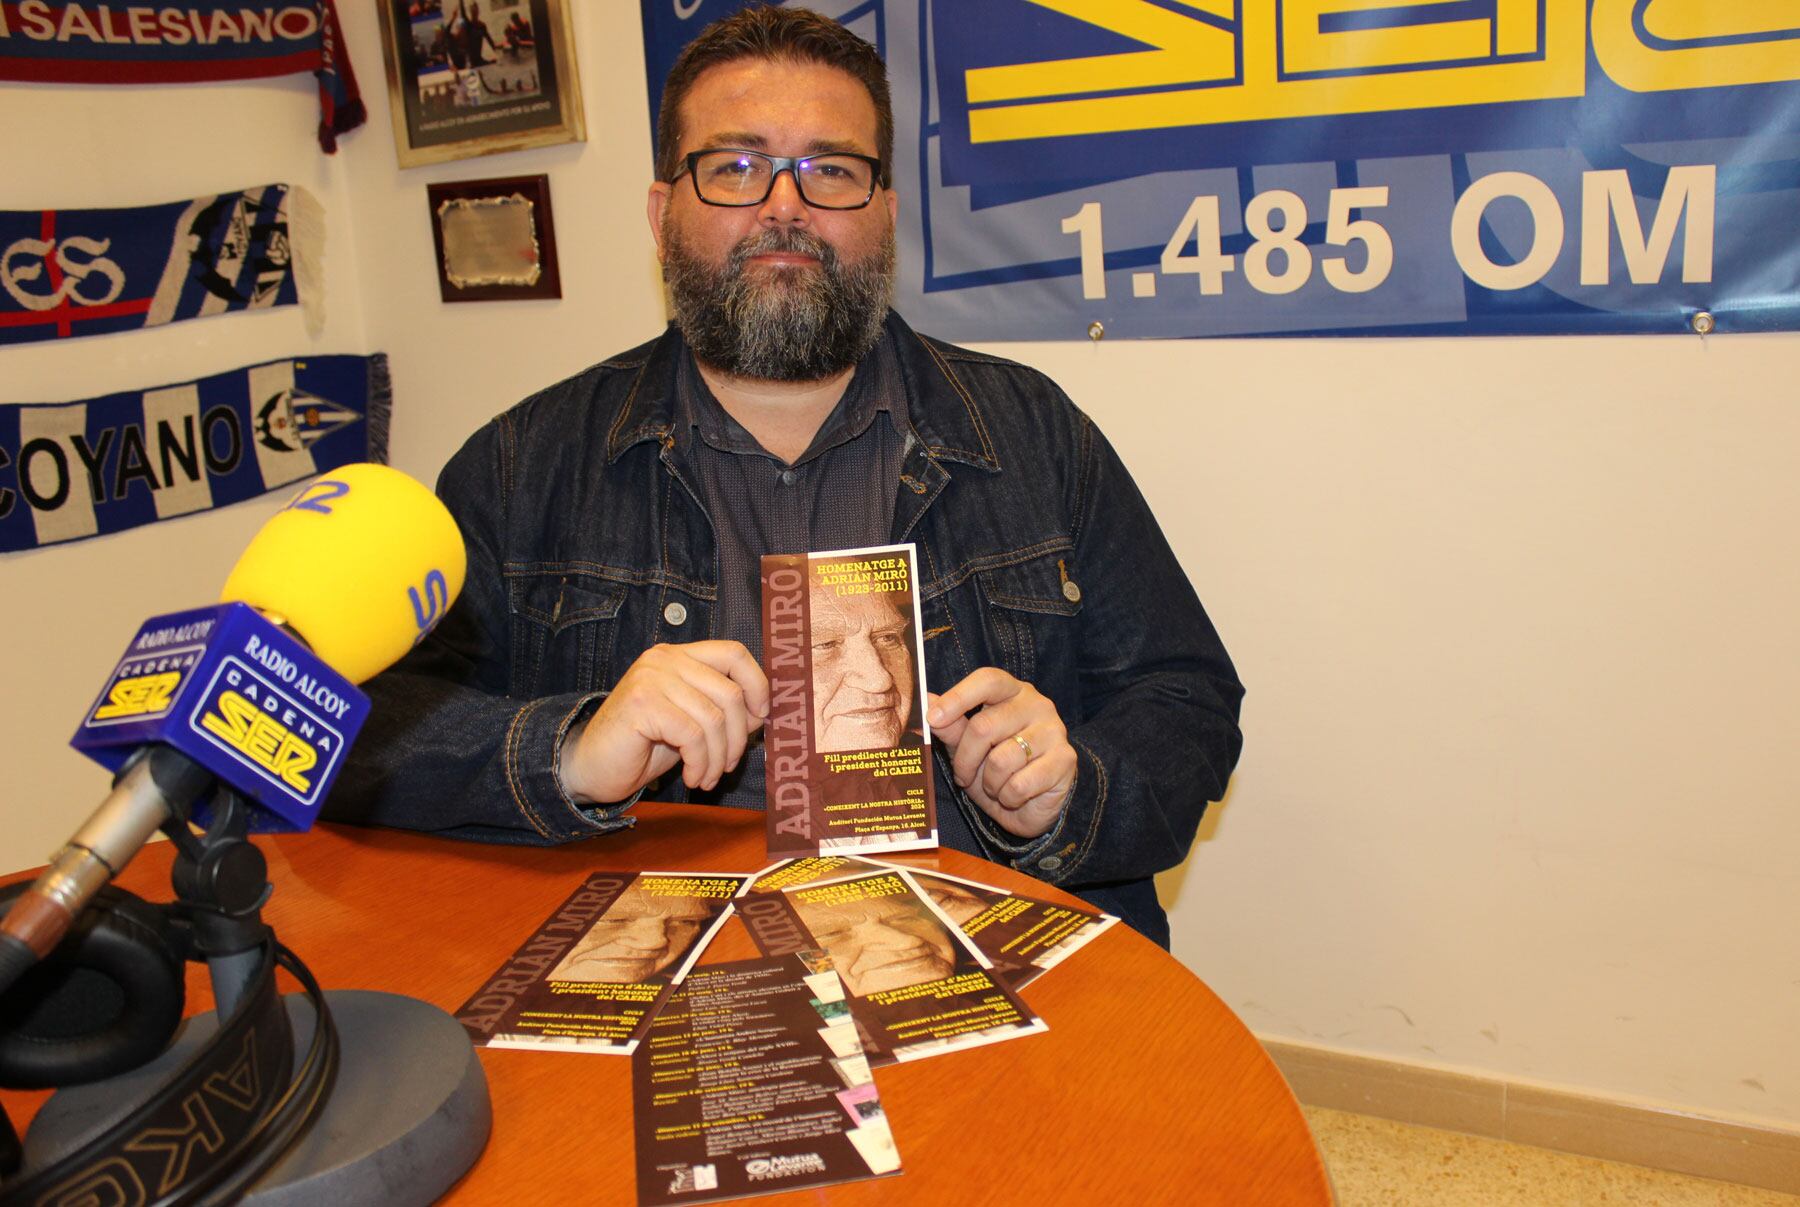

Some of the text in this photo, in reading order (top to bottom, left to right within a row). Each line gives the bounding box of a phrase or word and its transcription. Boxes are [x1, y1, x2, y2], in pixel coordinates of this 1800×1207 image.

[18, 0, 318, 44] SALESIANO
[1060, 164, 1717, 299] 1.485 OM
[0, 404, 241, 519] OYANO
[816, 558, 908, 574] HOMENATGE A
[874, 567, 908, 582] MIRÓ
[120, 655, 195, 677] CADENA
[244, 634, 350, 720] RADIO ALCOY
[94, 671, 182, 720] SER
[226, 669, 332, 752] CADENA
[761, 568, 812, 840] ADRIÁN MIRÓ
[201, 690, 318, 794] SER
[824, 754, 840, 763] Fill
[842, 751, 888, 763] predilecte
[835, 761, 880, 773] president
[881, 758, 921, 767] honorari
[796, 878, 887, 899] HOMENATGE
[885, 989, 938, 1005] president
[889, 981, 945, 998] predilecte
